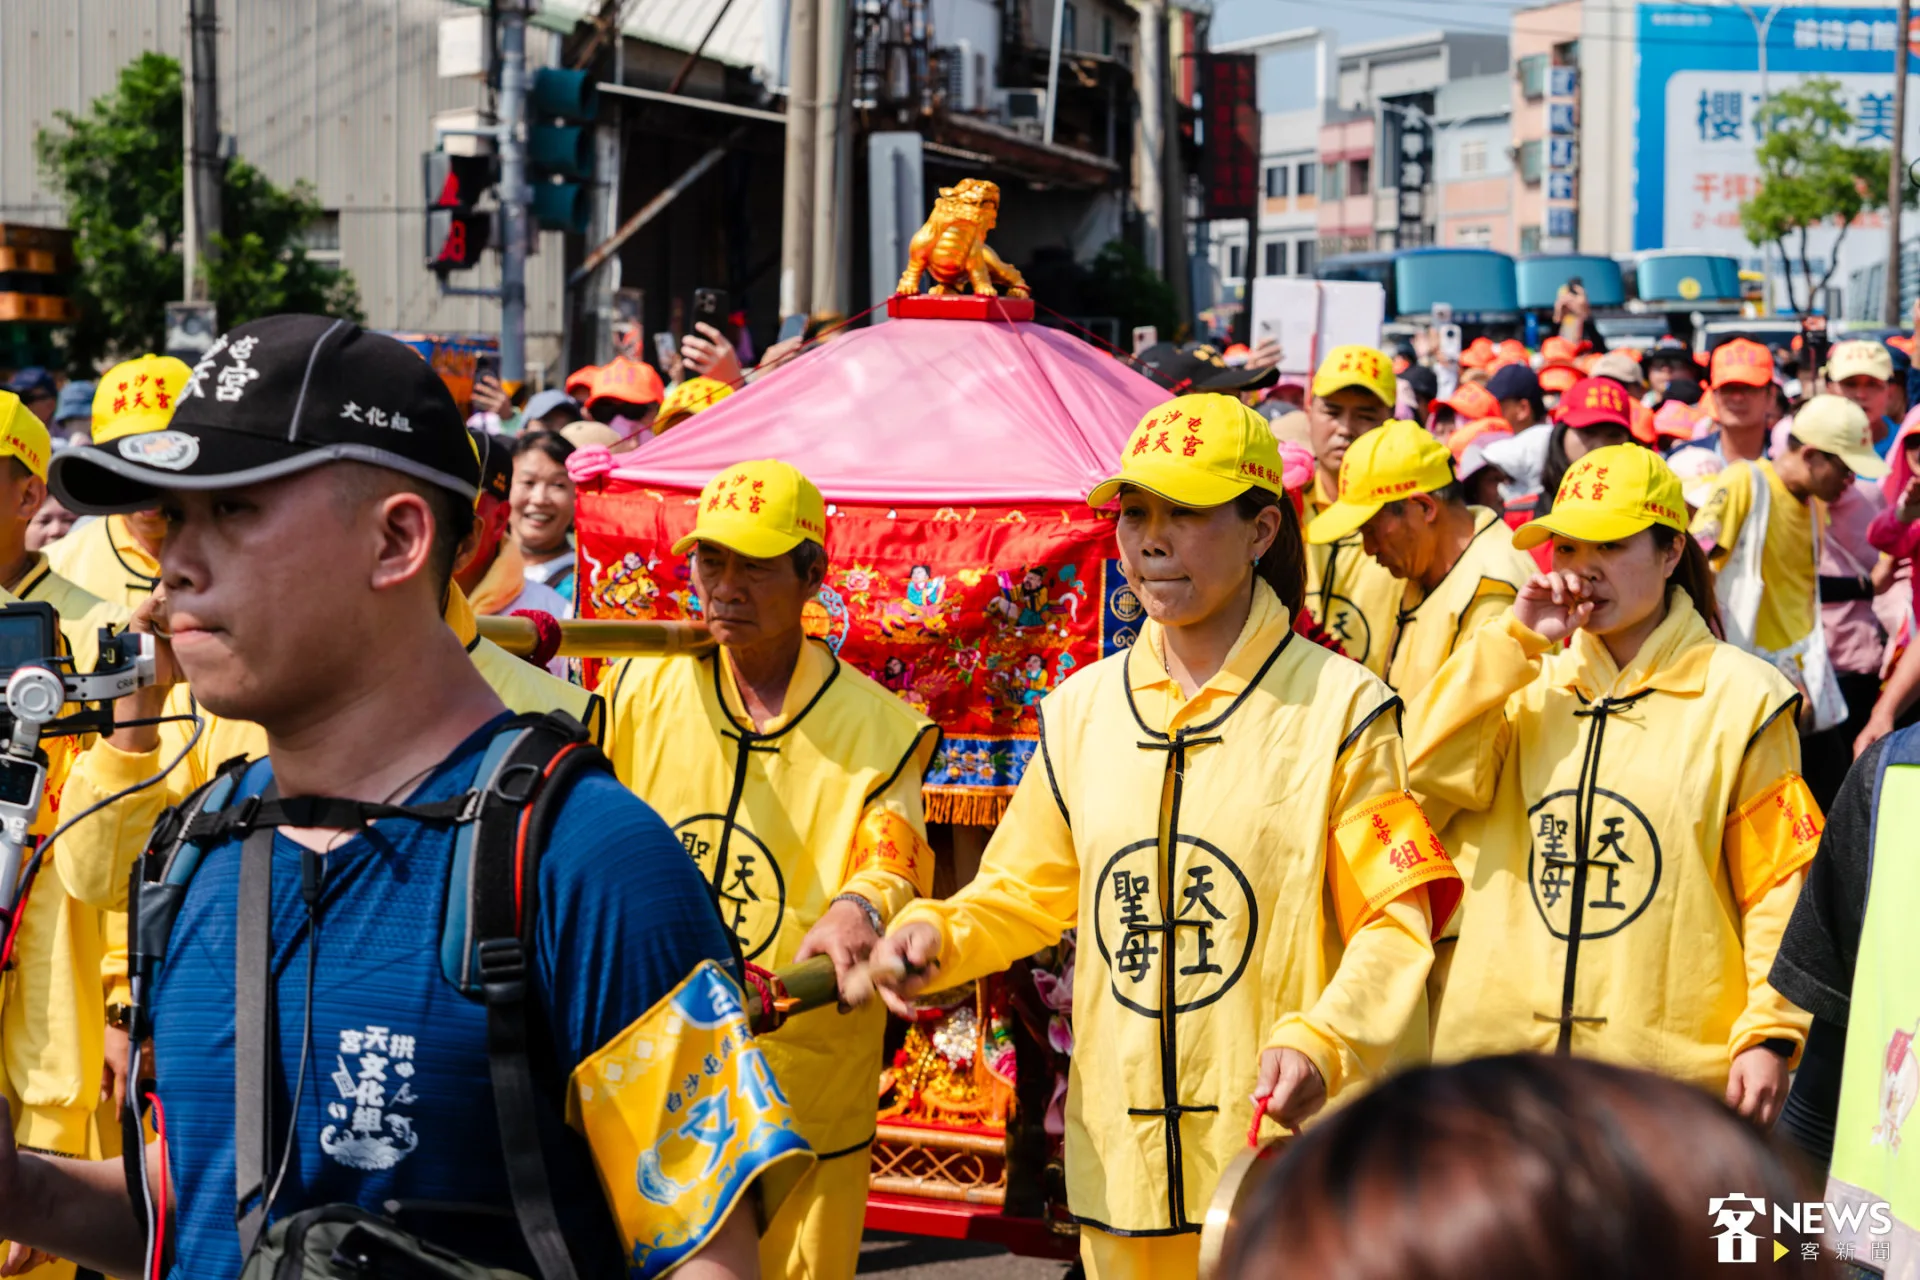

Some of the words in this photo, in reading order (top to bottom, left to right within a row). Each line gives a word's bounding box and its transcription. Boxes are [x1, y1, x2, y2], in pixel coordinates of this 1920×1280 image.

[338, 400, 414, 433] 文化組
[351, 1051, 390, 1132] 文化組
